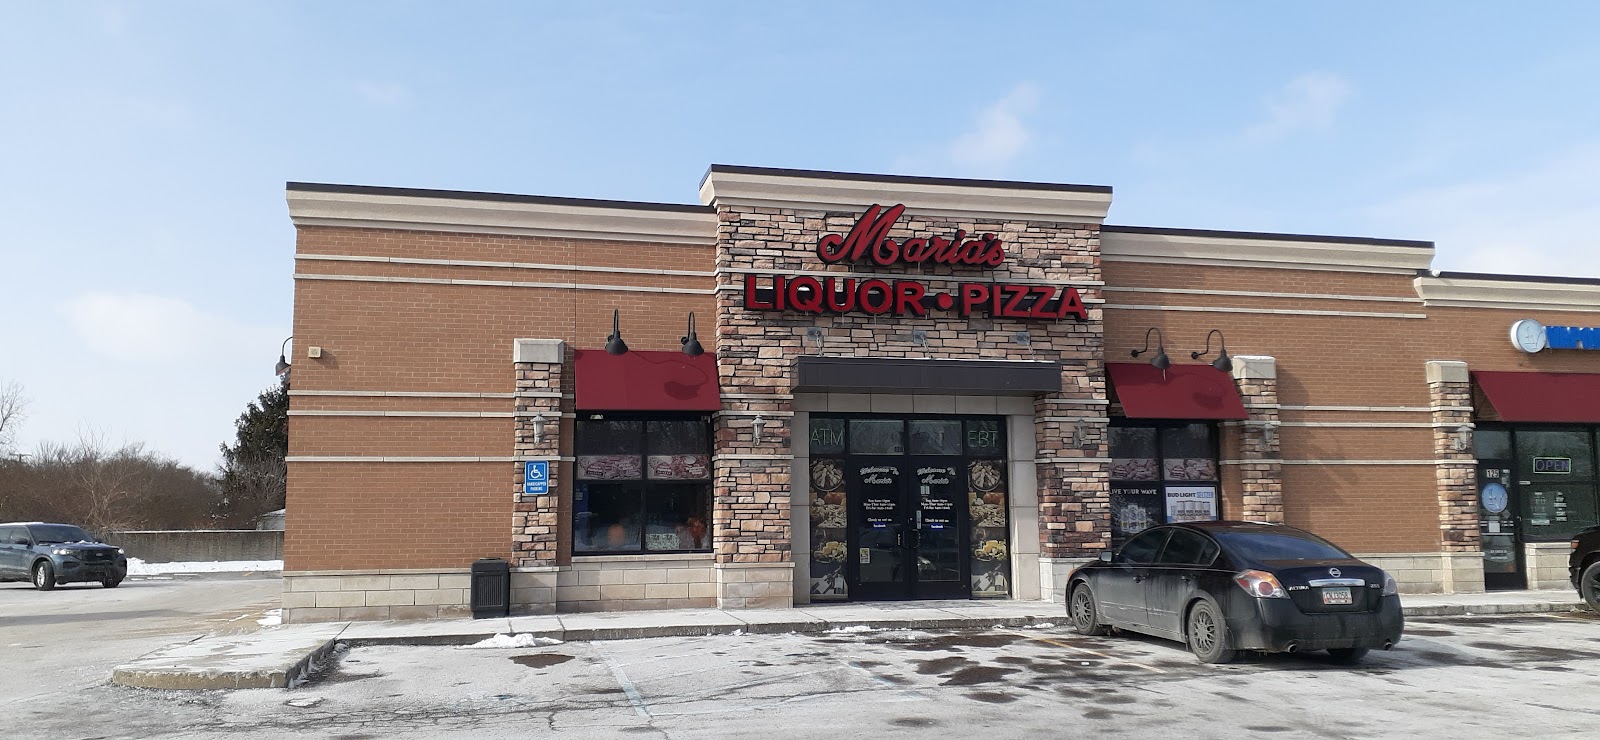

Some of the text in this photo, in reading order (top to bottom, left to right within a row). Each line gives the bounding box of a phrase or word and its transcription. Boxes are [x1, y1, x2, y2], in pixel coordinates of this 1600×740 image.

[816, 203, 1006, 267] Maria's
[745, 274, 1089, 321] LIQUOR PIZZA
[810, 428, 844, 446] ATM
[967, 430, 998, 447] EBT
[1487, 469, 1499, 478] 125
[1535, 459, 1569, 471] OPEN
